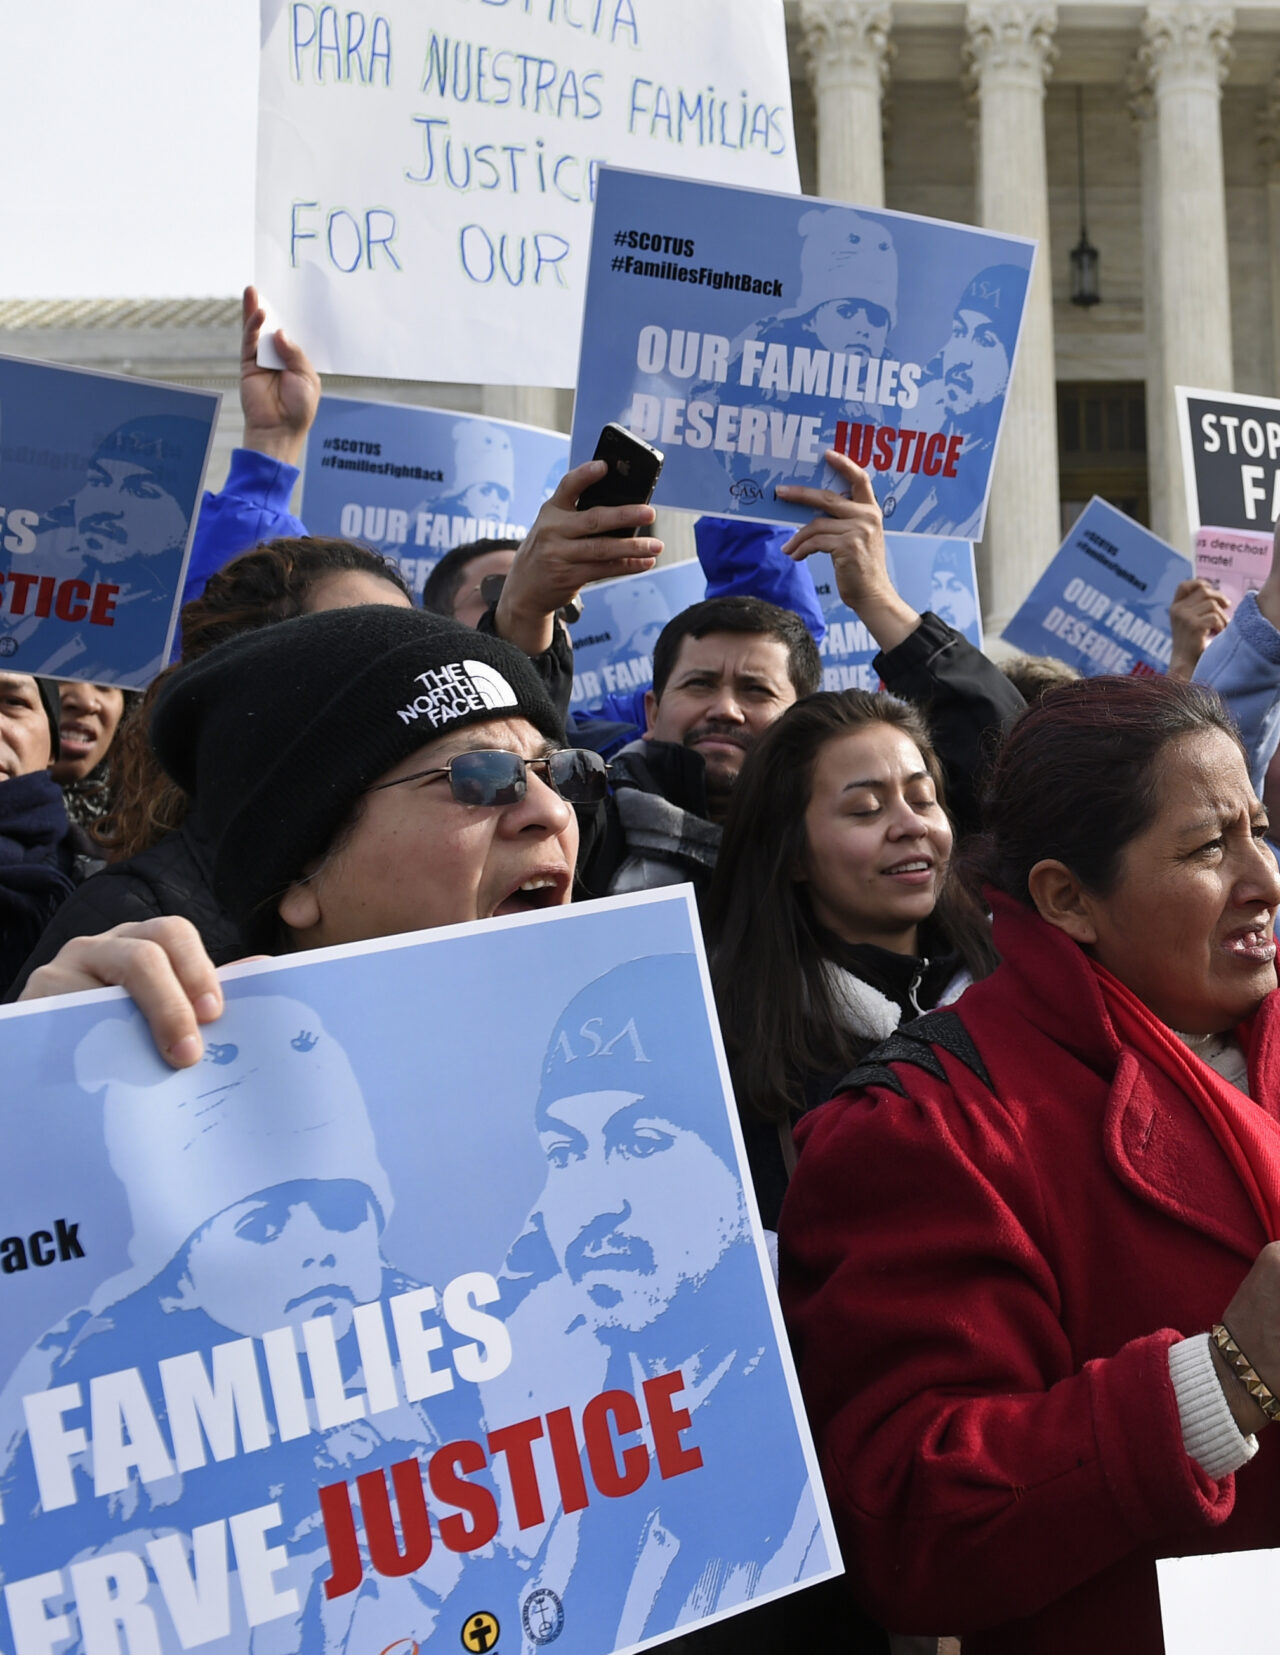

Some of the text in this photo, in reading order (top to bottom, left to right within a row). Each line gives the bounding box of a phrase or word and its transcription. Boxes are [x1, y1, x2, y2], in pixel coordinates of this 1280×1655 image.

[292, 3, 392, 86] PARA
[422, 33, 603, 119] NUESTRAS
[290, 201, 571, 287] FOR OUR
[613, 229, 695, 259] #SCOTUS
[611, 255, 783, 298] #FamiliesFightBack
[636, 325, 922, 410] OUR FAMILIES
[323, 437, 382, 457] #SCOTUS
[629, 393, 964, 478] DESERVE JUSTICE
[340, 503, 408, 545] OUR
[1063, 577, 1111, 621] OUR
[413, 663, 466, 690] THE
[396, 677, 477, 725] NORTH
[427, 694, 485, 728] FACE
[22, 1271, 513, 1513] FAMILIES
[317, 1369, 704, 1601] JUSTICE
